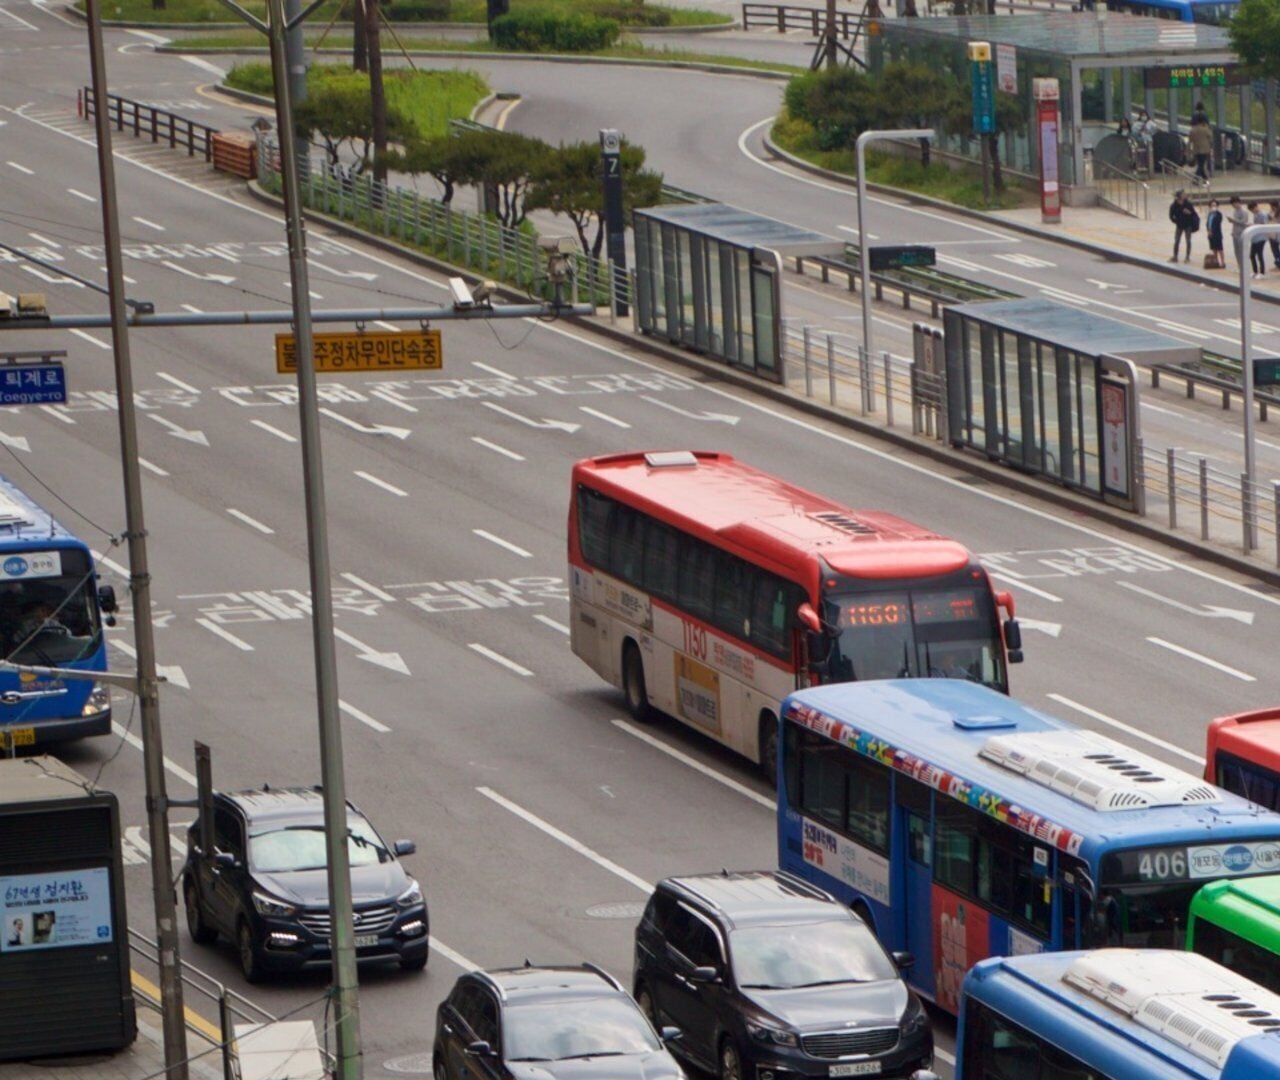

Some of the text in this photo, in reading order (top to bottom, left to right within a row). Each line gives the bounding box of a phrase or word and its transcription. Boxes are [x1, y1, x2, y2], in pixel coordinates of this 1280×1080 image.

[608, 158, 618, 174] 7
[283, 338, 435, 368] 불주정차무인단속중
[6, 370, 60, 388] 퇴계로
[681, 618, 707, 660] 1150
[1139, 852, 1185, 878] 406
